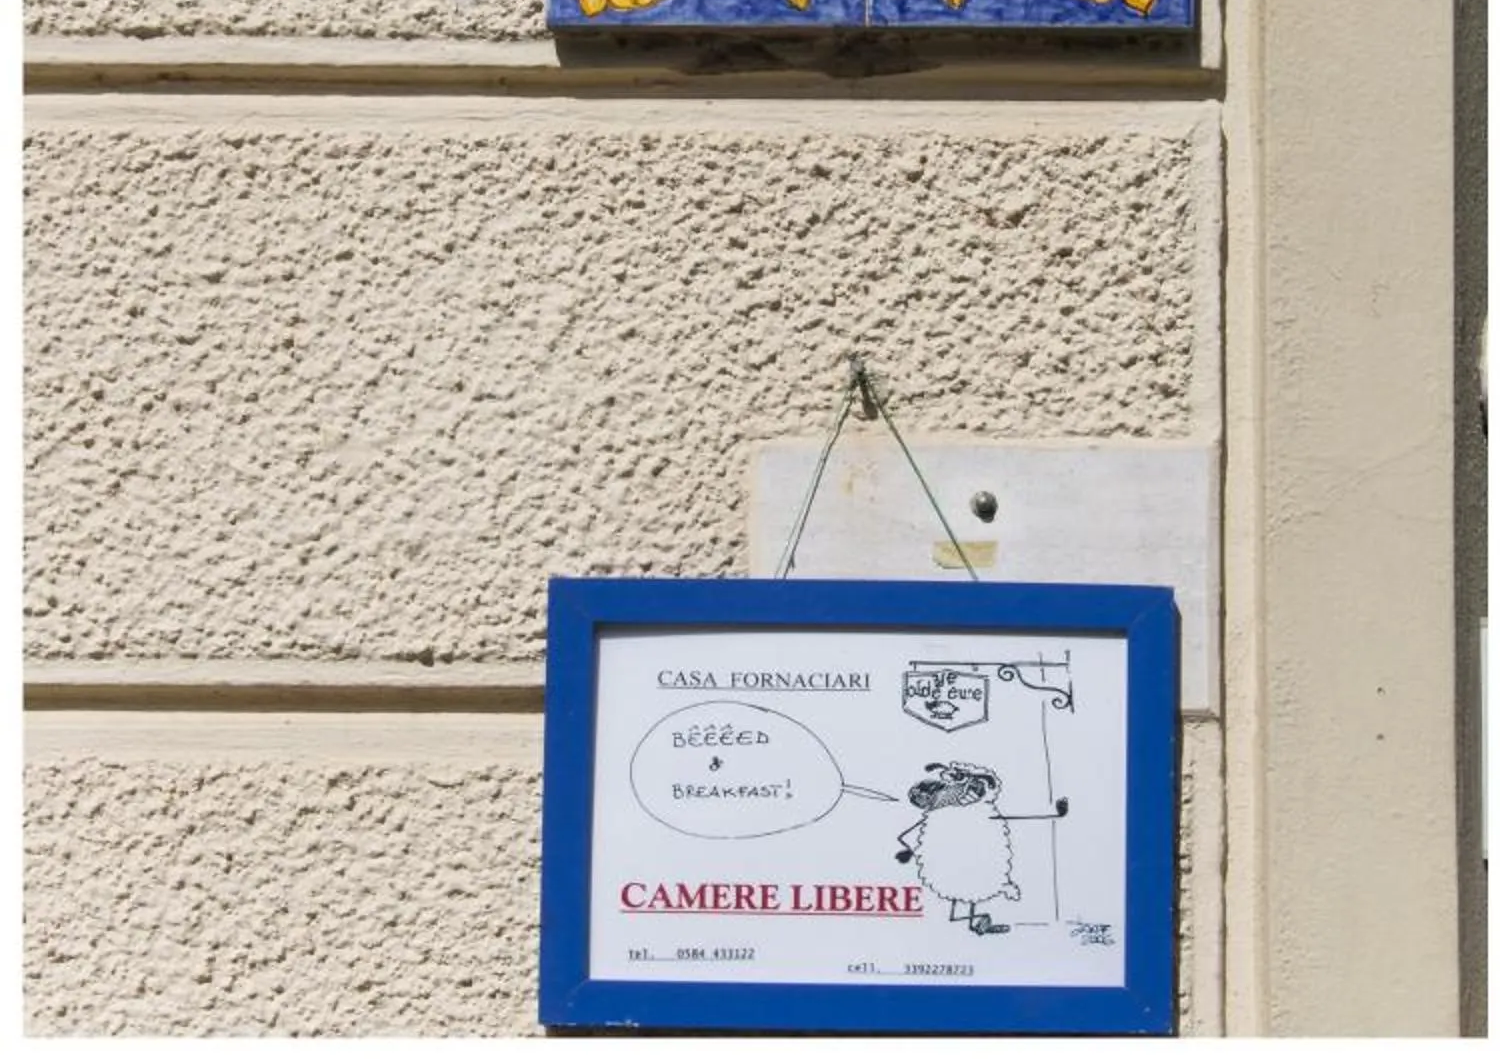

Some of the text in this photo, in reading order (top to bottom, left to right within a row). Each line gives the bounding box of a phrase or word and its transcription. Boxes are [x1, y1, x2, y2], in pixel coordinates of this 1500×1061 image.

[657, 670, 870, 690] CASA FORNACIARI
[709, 756, 724, 771] &
[672, 779, 793, 800] BREAKFAST!
[620, 882, 924, 913] CAMERE LIBERE
[628, 948, 655, 960] tel.
[847, 962, 880, 974] cell.
